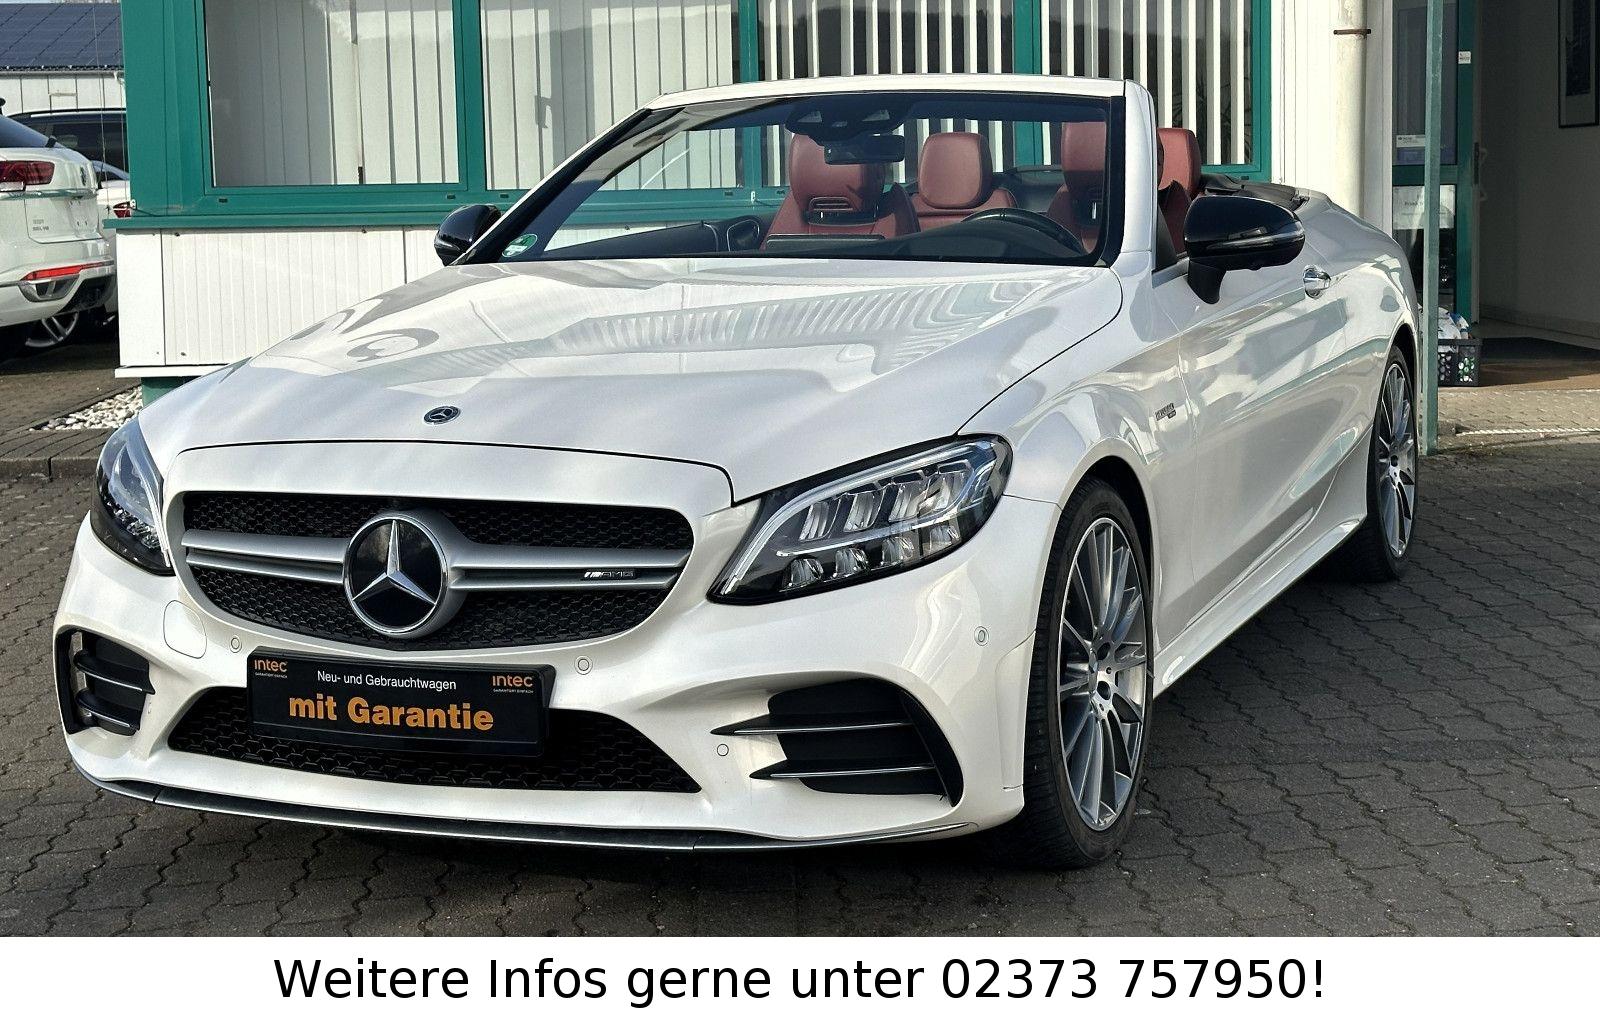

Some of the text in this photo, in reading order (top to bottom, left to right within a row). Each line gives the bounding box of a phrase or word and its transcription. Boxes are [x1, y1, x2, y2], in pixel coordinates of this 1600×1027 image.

[317, 670, 457, 692] Neu- und Gebrauchtwagen
[289, 693, 494, 731] mit Garantie
